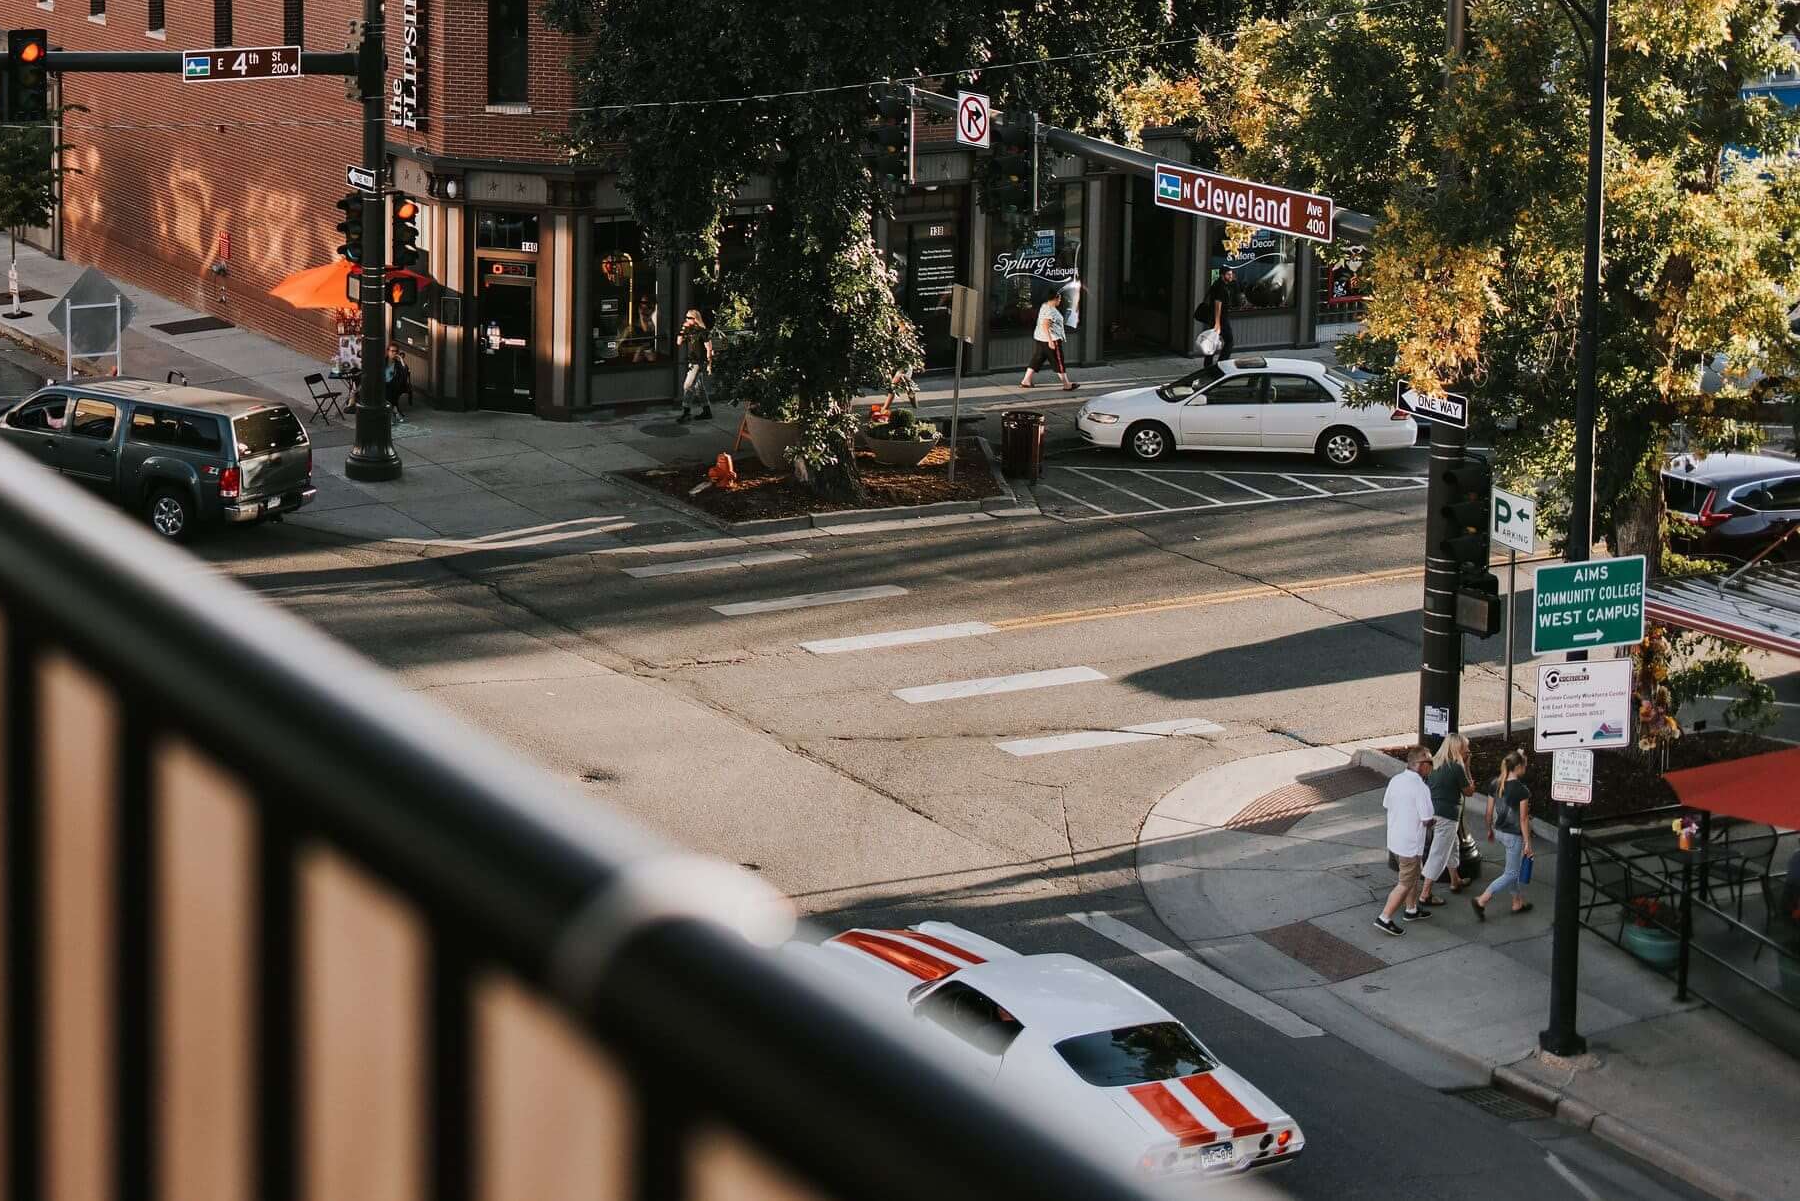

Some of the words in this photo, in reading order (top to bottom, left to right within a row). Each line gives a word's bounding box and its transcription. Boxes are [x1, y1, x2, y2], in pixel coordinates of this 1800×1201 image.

[217, 58, 224, 70] E
[231, 52, 259, 76] 4th
[271, 51, 281, 62] St
[271, 63, 289, 74] 200
[390, 78, 402, 127] the
[1183, 182, 1191, 199] N
[1193, 177, 1291, 228] Cleveland
[1306, 201, 1323, 217] Ave
[1306, 219, 1326, 235] 400
[521, 241, 538, 252] 140
[1252, 239, 1276, 249] Decor
[993, 252, 1056, 277] Splurge
[1418, 396, 1437, 410] ONE
[1440, 399, 1459, 415] WAY
[1573, 565, 1609, 583] AIMS
[1537, 587, 1596, 607] COMMUNITY
[1599, 582, 1642, 601] COLLEGE
[1538, 610, 1582, 628] WEST
[1586, 603, 1640, 623] CAMPUS
[1558, 758, 1588, 767] PARKING
